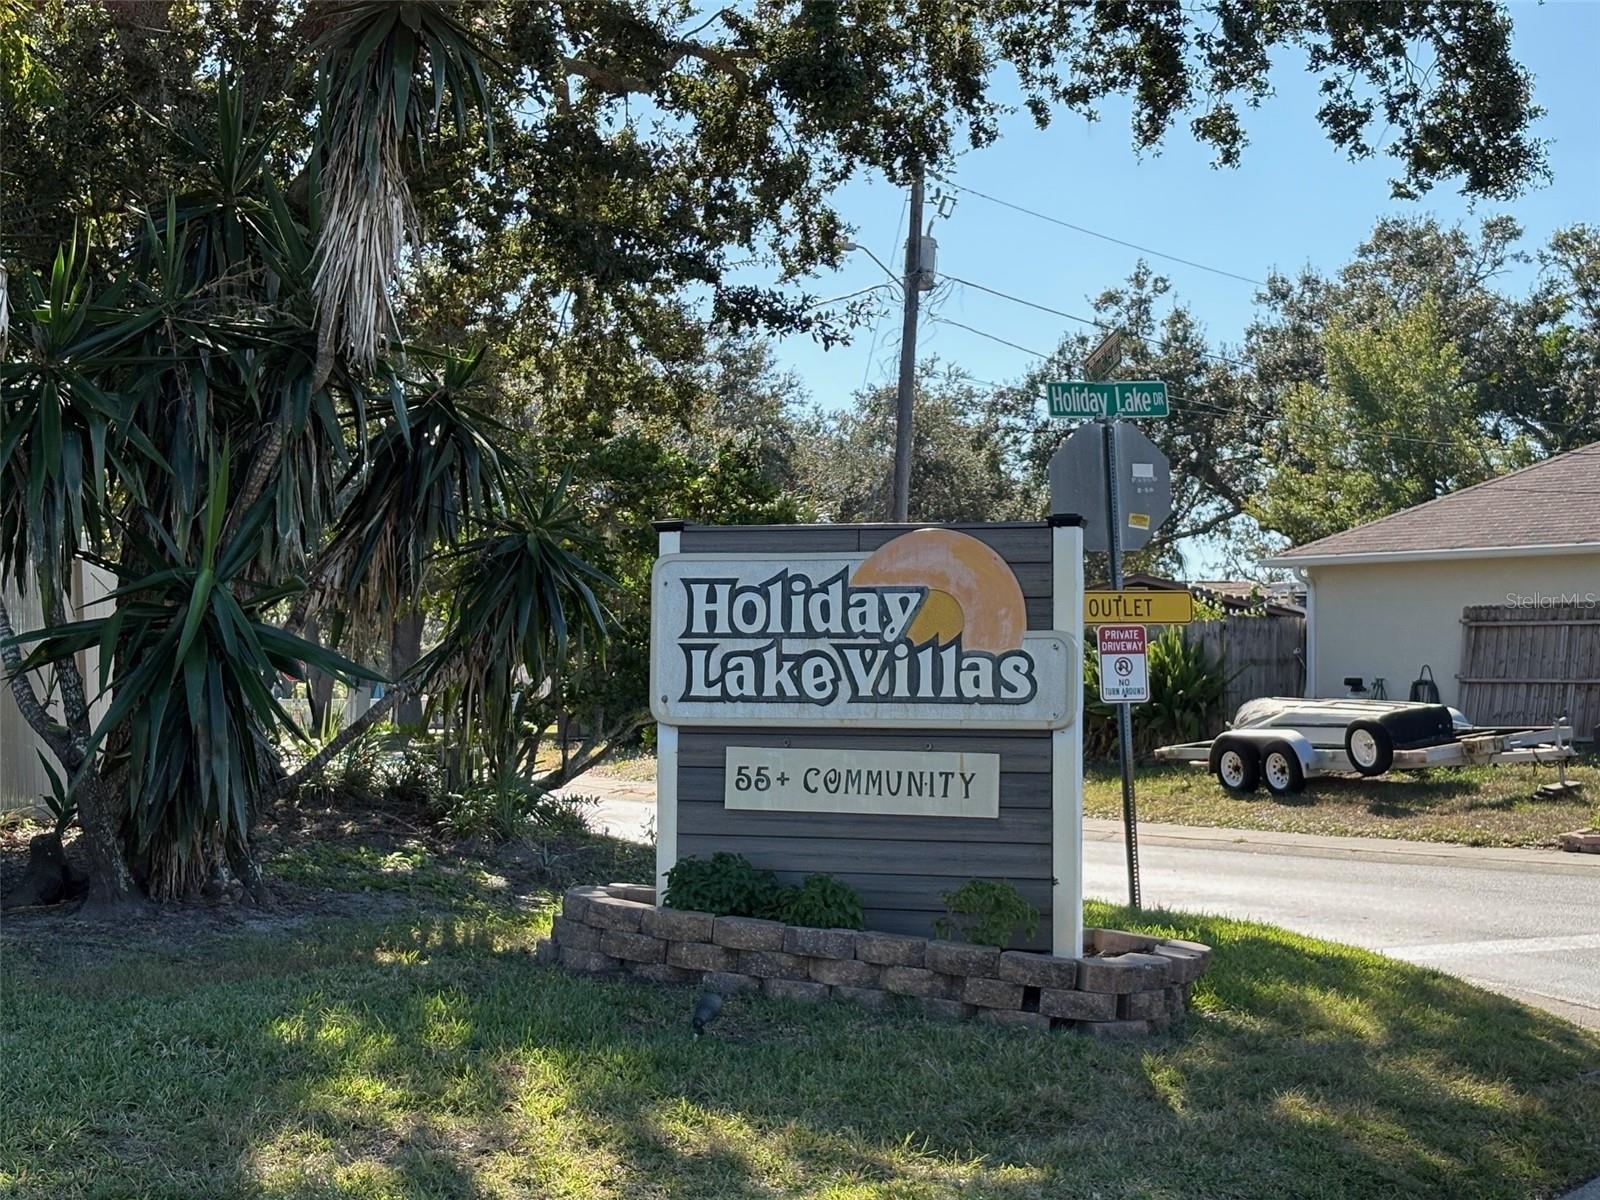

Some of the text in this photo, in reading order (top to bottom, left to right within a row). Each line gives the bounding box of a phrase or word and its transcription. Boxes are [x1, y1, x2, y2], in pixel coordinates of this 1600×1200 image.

[1052, 386, 1164, 415] Holiday Lake DR
[680, 567, 928, 643] Holiday
[1088, 598, 1152, 617] OUTLET
[1104, 629, 1139, 640] PRIVATE
[1101, 641, 1143, 652] DRIVEWAY
[679, 634, 1037, 706] Lake Villas
[1104, 687, 1145, 696] TURN AROUND
[1118, 678, 1130, 687] NO
[734, 765, 977, 799] 55+ COMMUNITY
